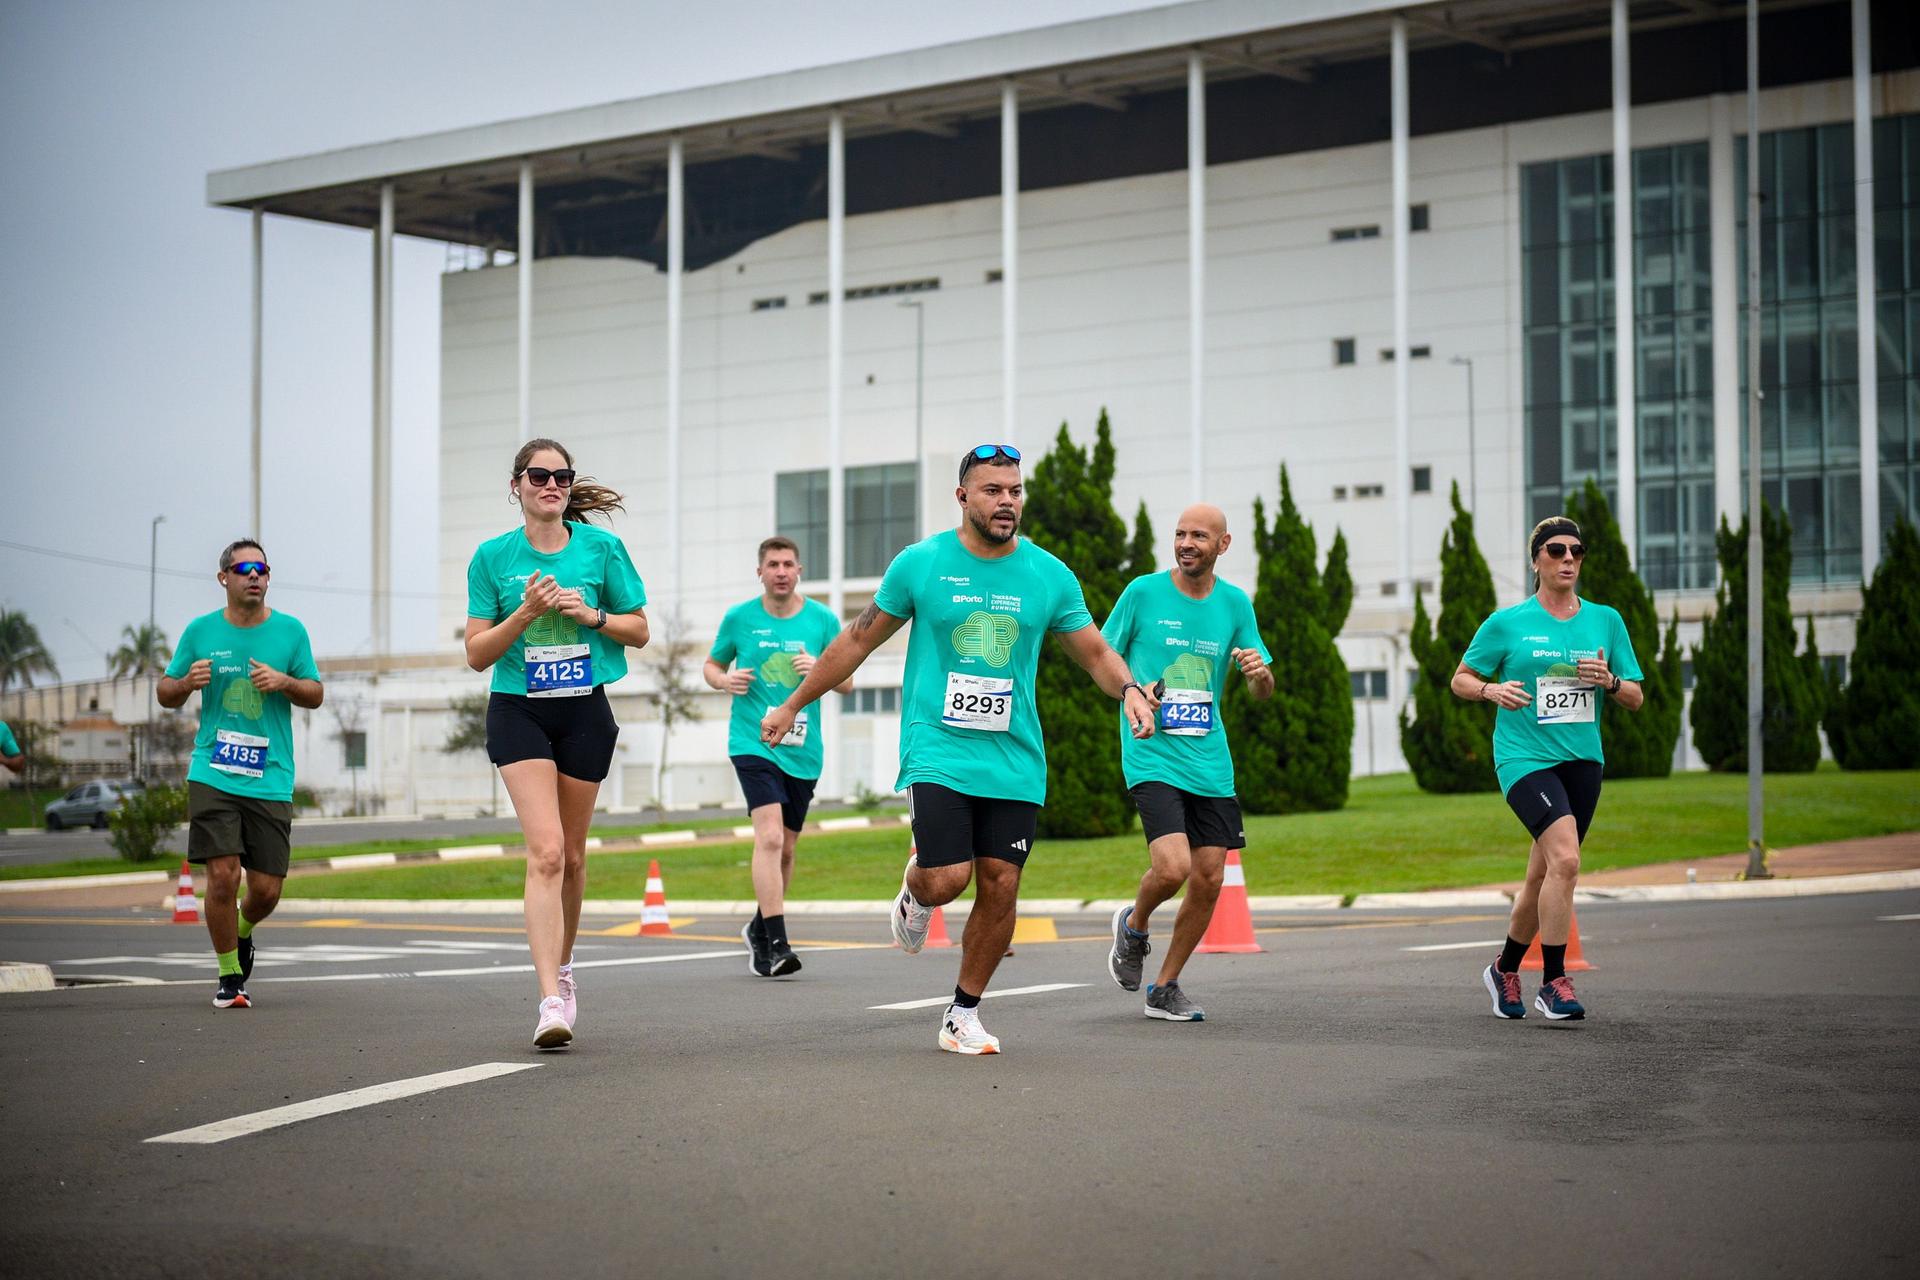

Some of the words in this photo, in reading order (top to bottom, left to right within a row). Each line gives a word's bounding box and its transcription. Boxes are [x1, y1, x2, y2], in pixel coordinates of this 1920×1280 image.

[961, 595, 983, 603] Porto
[991, 605, 1021, 613] RUNNING
[1173, 637, 1190, 647] Porto
[224, 665, 242, 673] Porto
[534, 661, 585, 681] 4125
[952, 692, 1005, 715] 8293
[1545, 692, 1587, 708] 8271
[1167, 704, 1210, 722] 4228
[219, 743, 260, 764] 4135
